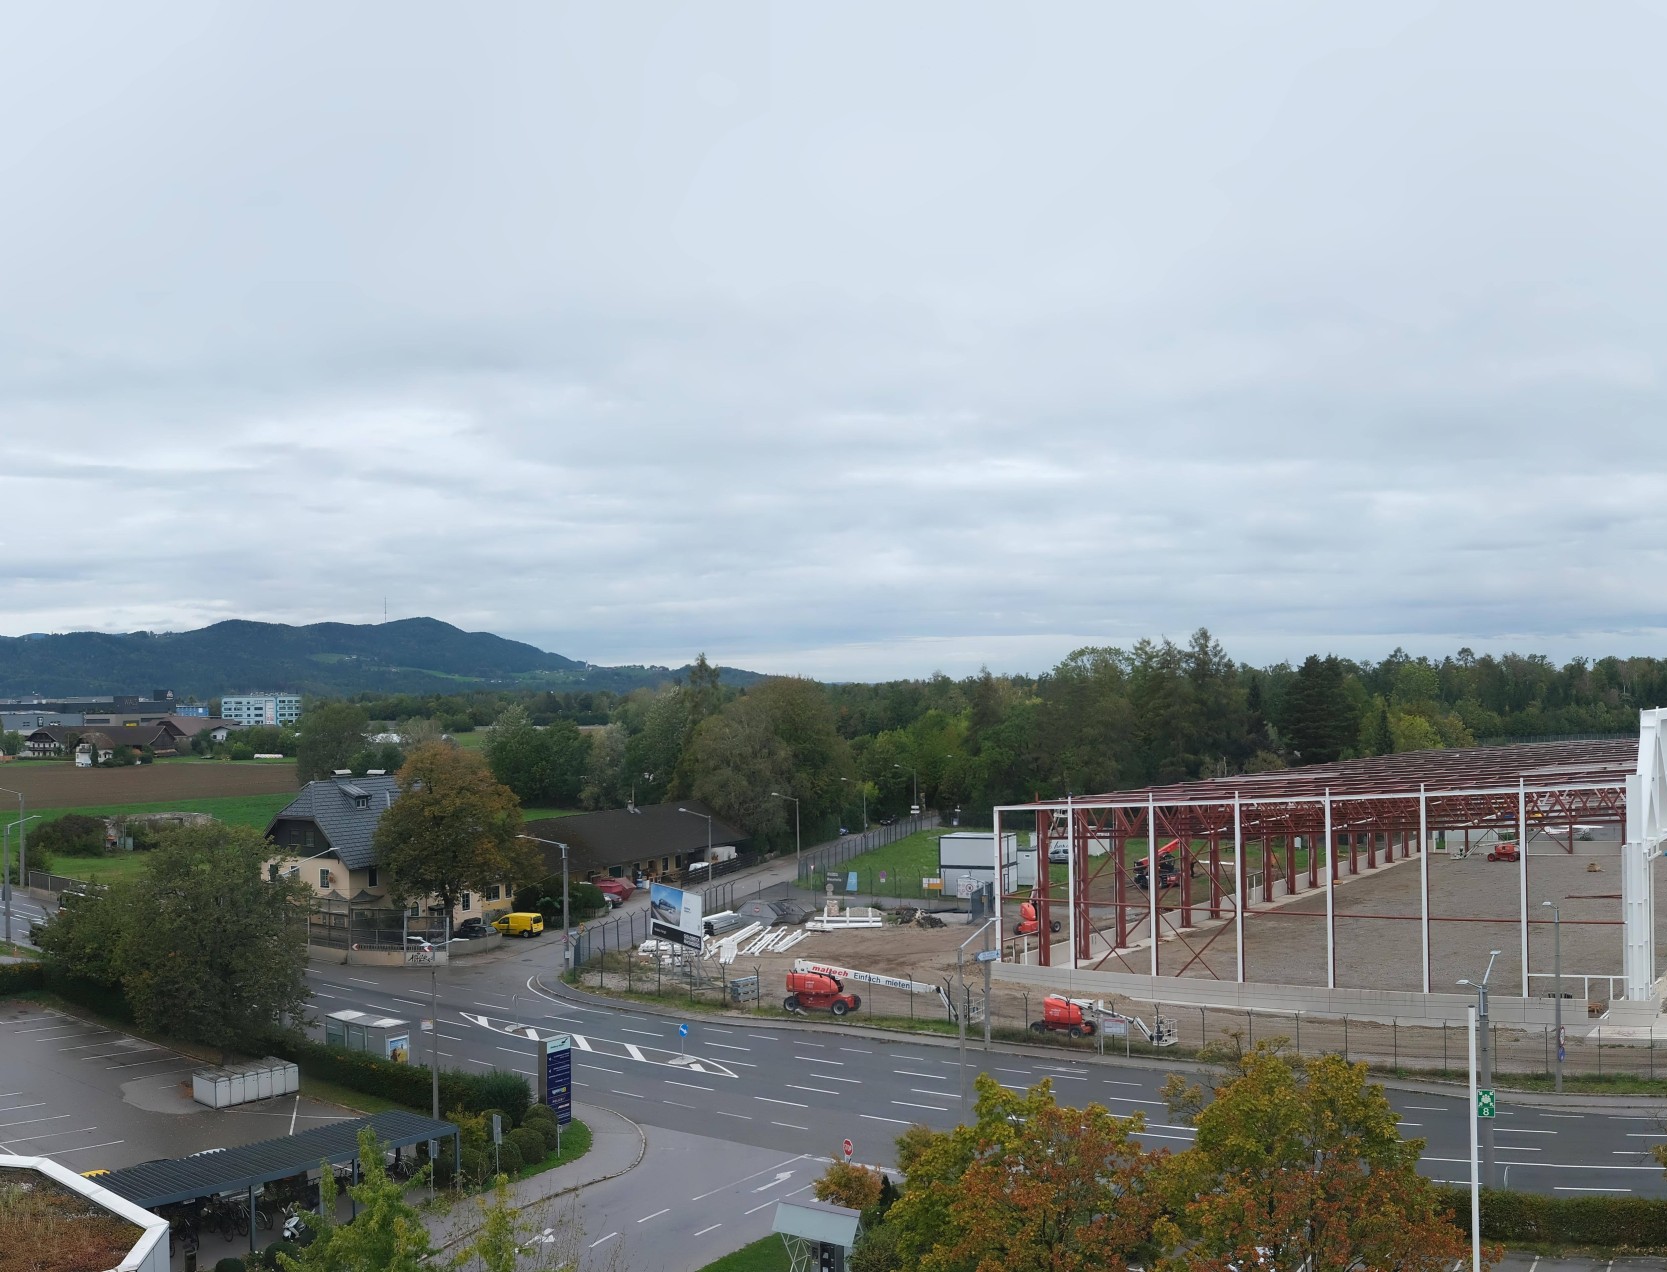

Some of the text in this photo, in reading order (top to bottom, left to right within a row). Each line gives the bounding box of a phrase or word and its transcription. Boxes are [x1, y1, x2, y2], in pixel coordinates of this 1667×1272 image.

[811, 965, 849, 977] maltech
[853, 972, 881, 984] Einfach
[885, 979, 910, 989] mieten
[1482, 1107, 1490, 1116] 8
